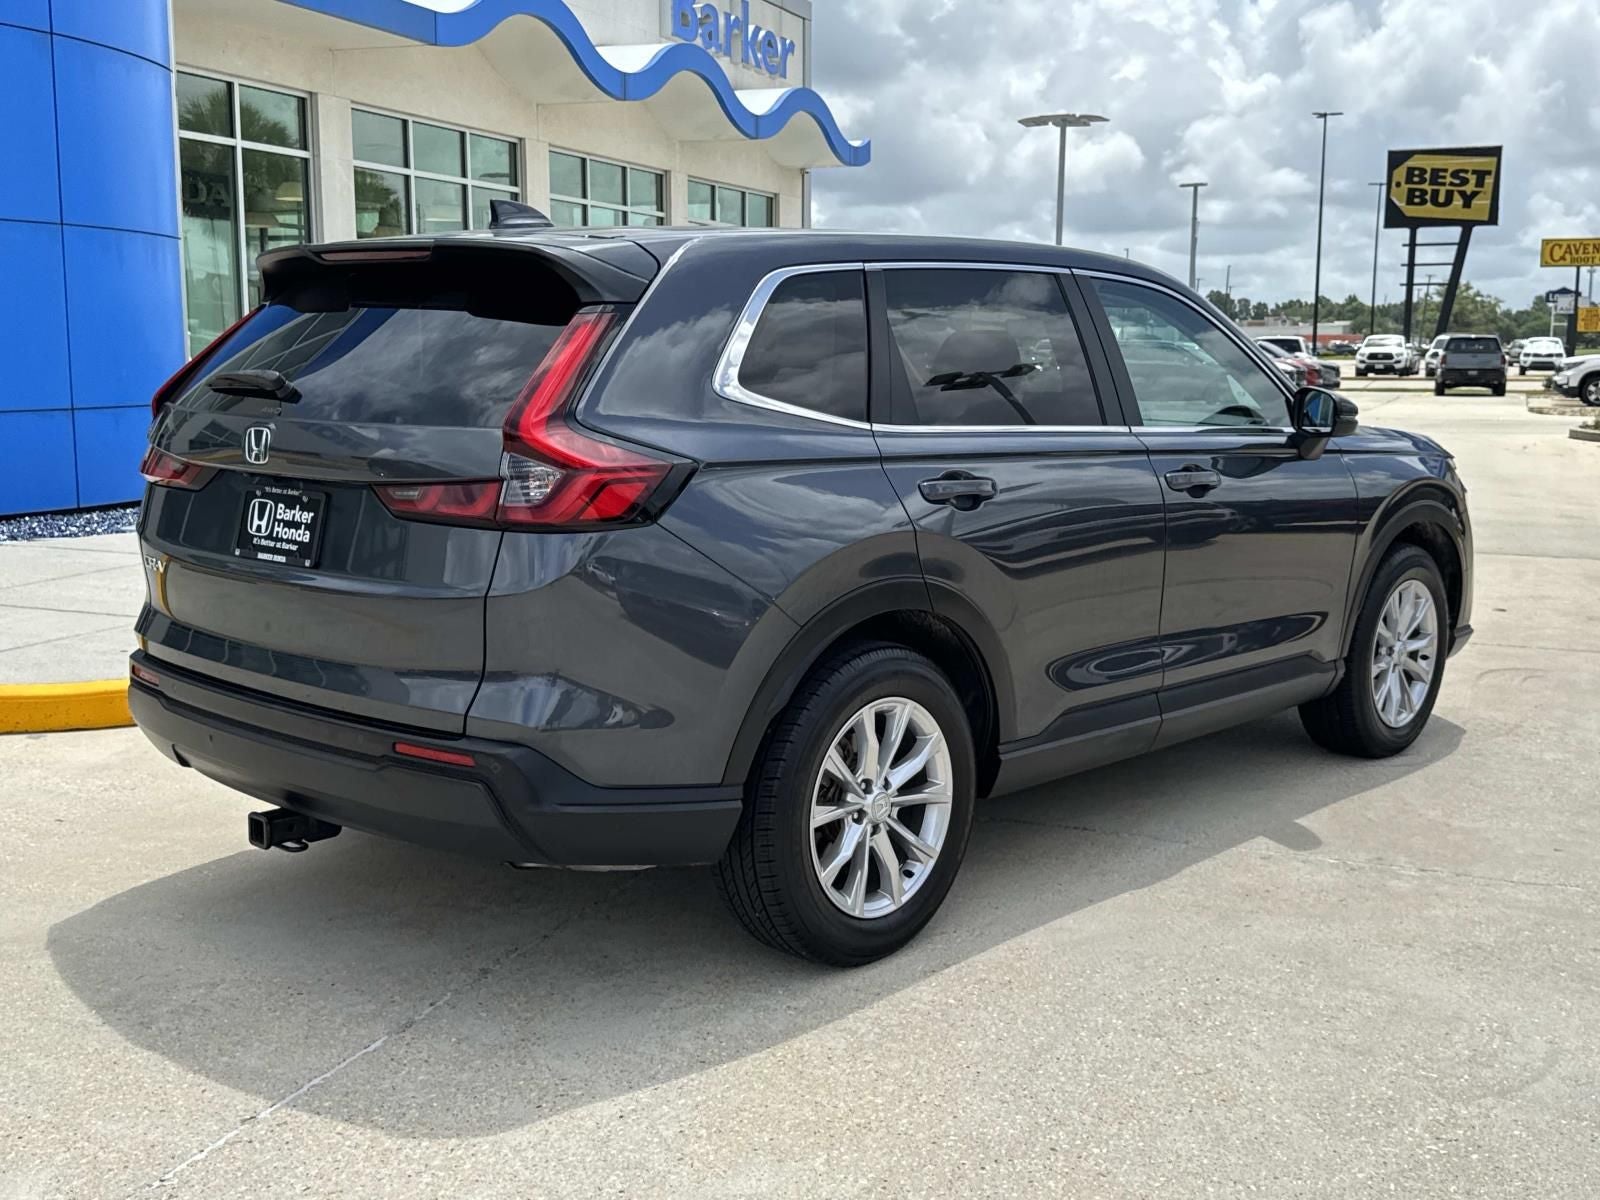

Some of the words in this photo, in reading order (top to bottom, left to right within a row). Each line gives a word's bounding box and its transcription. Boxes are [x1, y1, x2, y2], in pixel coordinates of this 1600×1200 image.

[672, 0, 795, 80] Barker
[1405, 166, 1492, 188] BEST
[1405, 187, 1482, 209] BUY
[276, 503, 314, 524] Barker
[273, 521, 311, 542] Honda
[259, 538, 275, 547] Better
[281, 541, 298, 551] Barker
